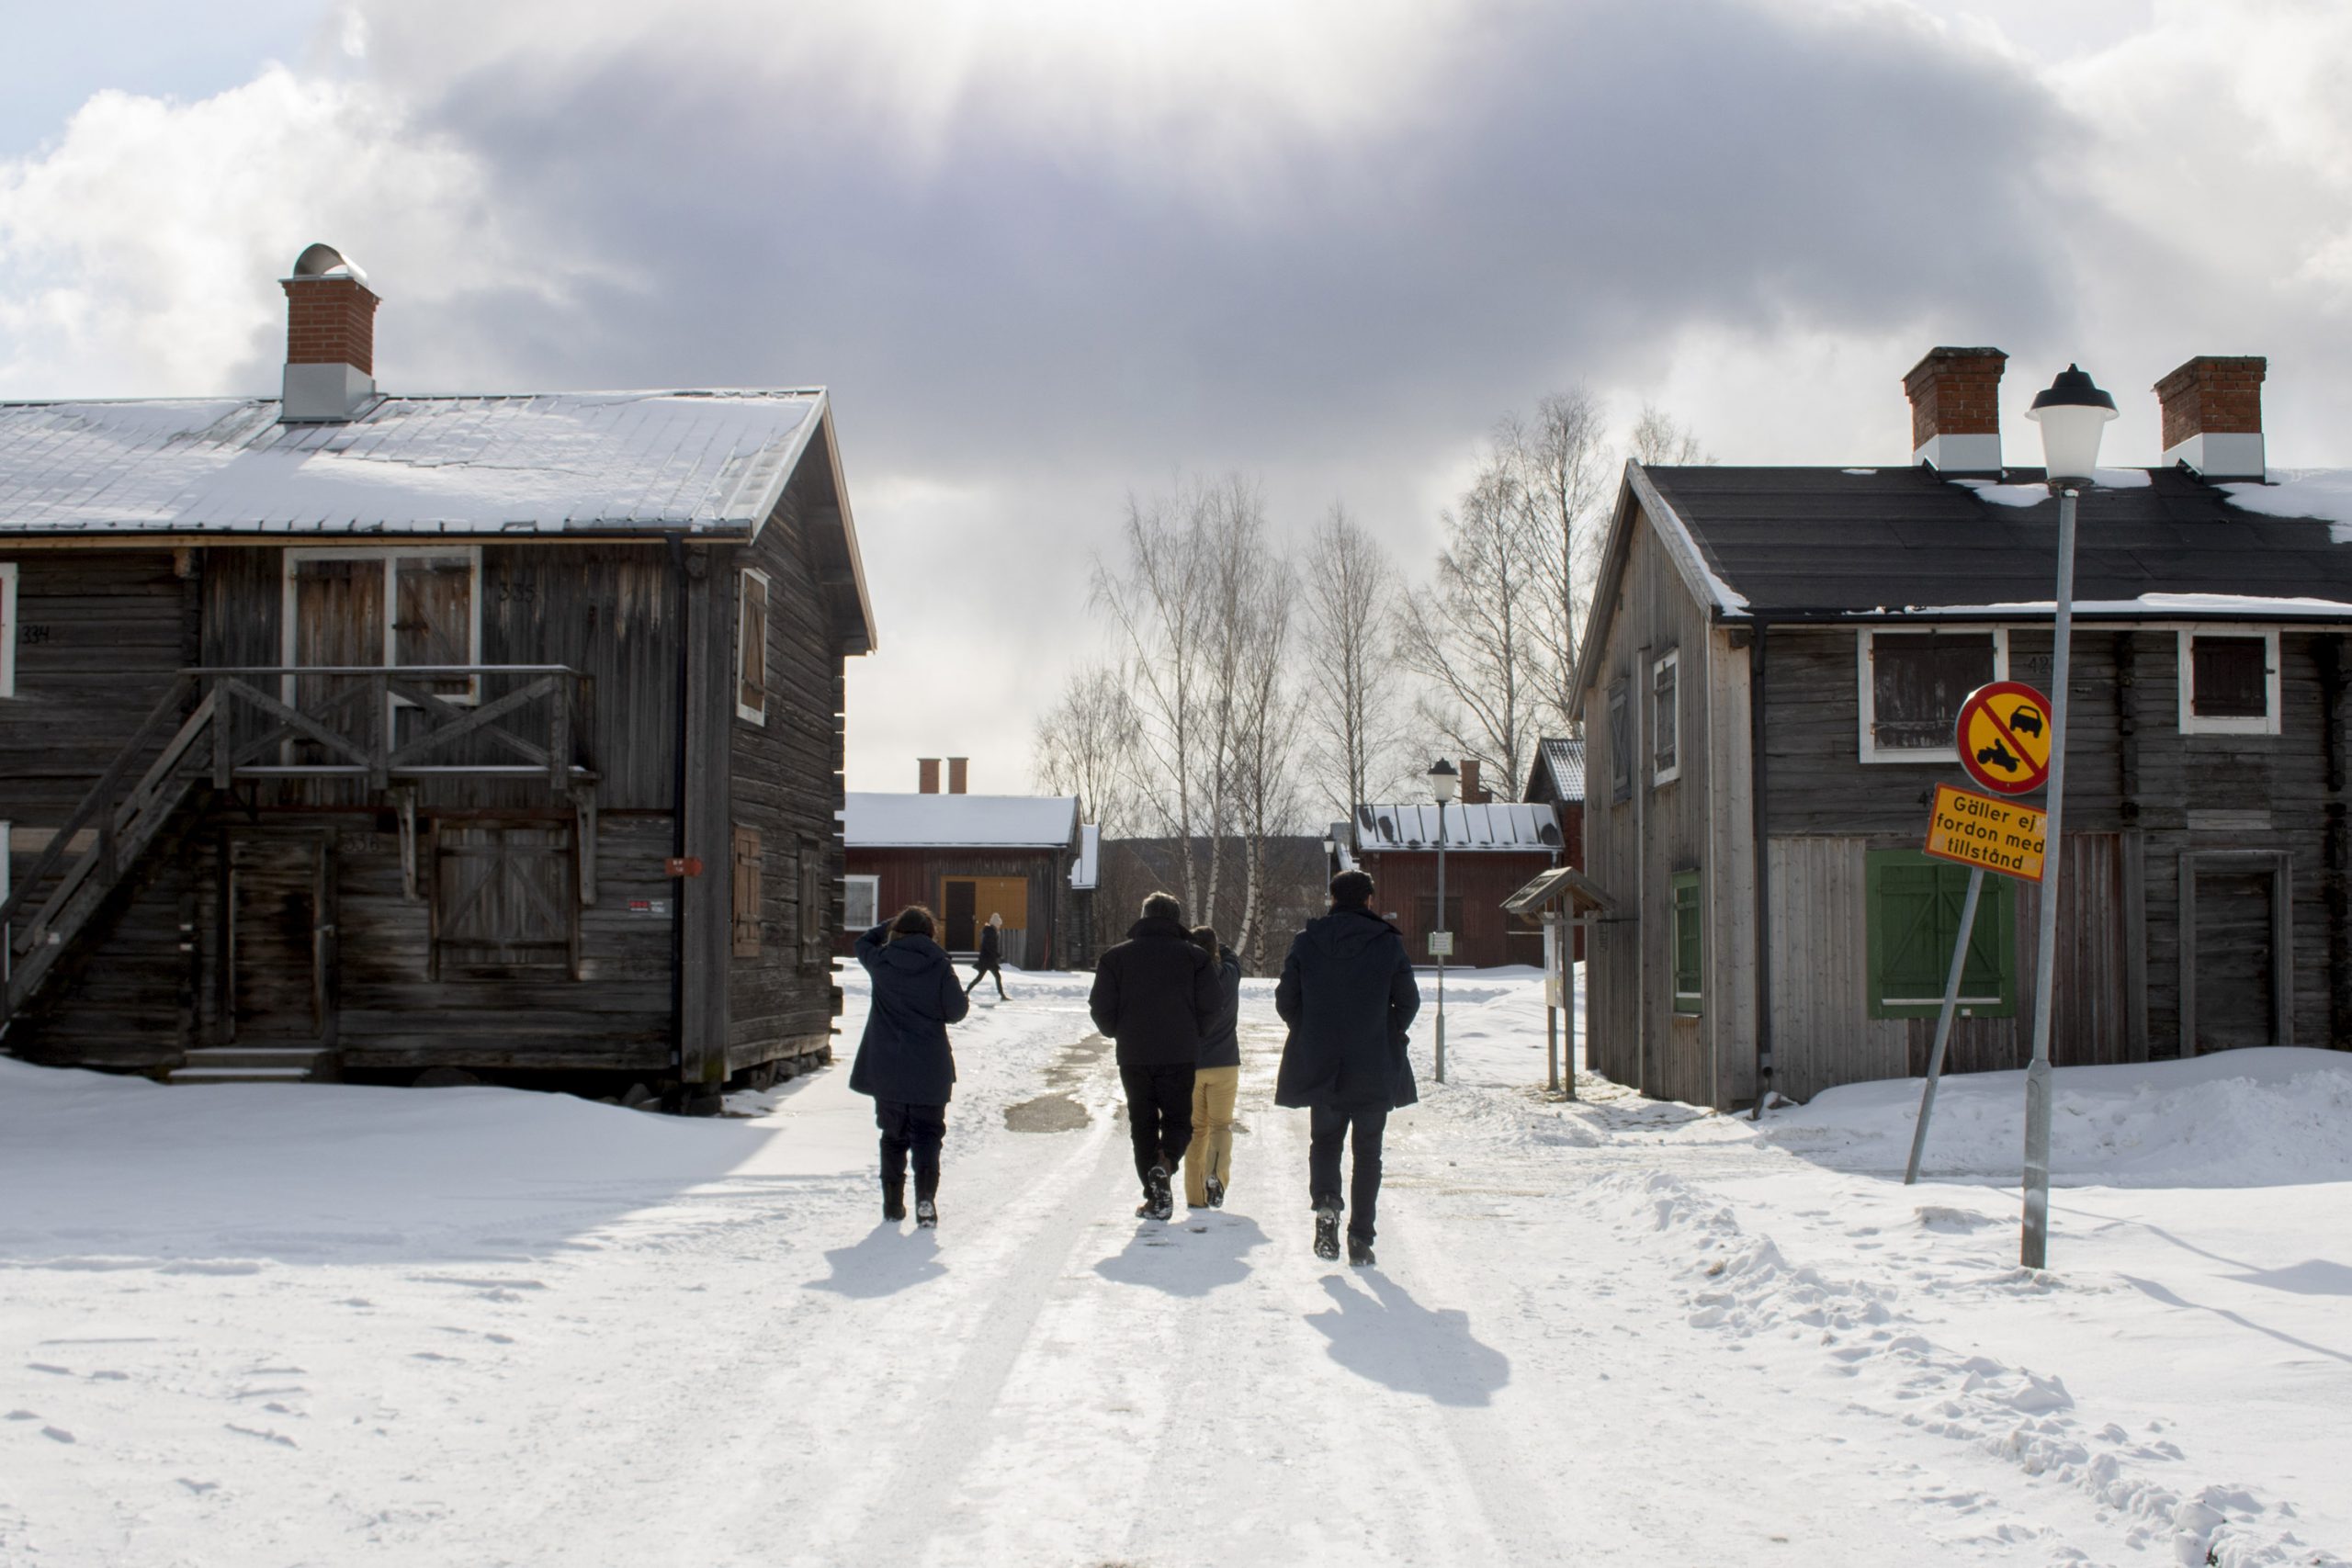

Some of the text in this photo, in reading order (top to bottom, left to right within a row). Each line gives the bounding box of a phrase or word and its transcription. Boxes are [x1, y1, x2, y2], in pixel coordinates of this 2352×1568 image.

[21, 626, 50, 644] 334
[2027, 656, 2053, 674] 42
[1953, 796, 2036, 832] Gäller ej
[1937, 813, 2045, 854] fordon med
[1948, 838, 2023, 870] tillstånd
